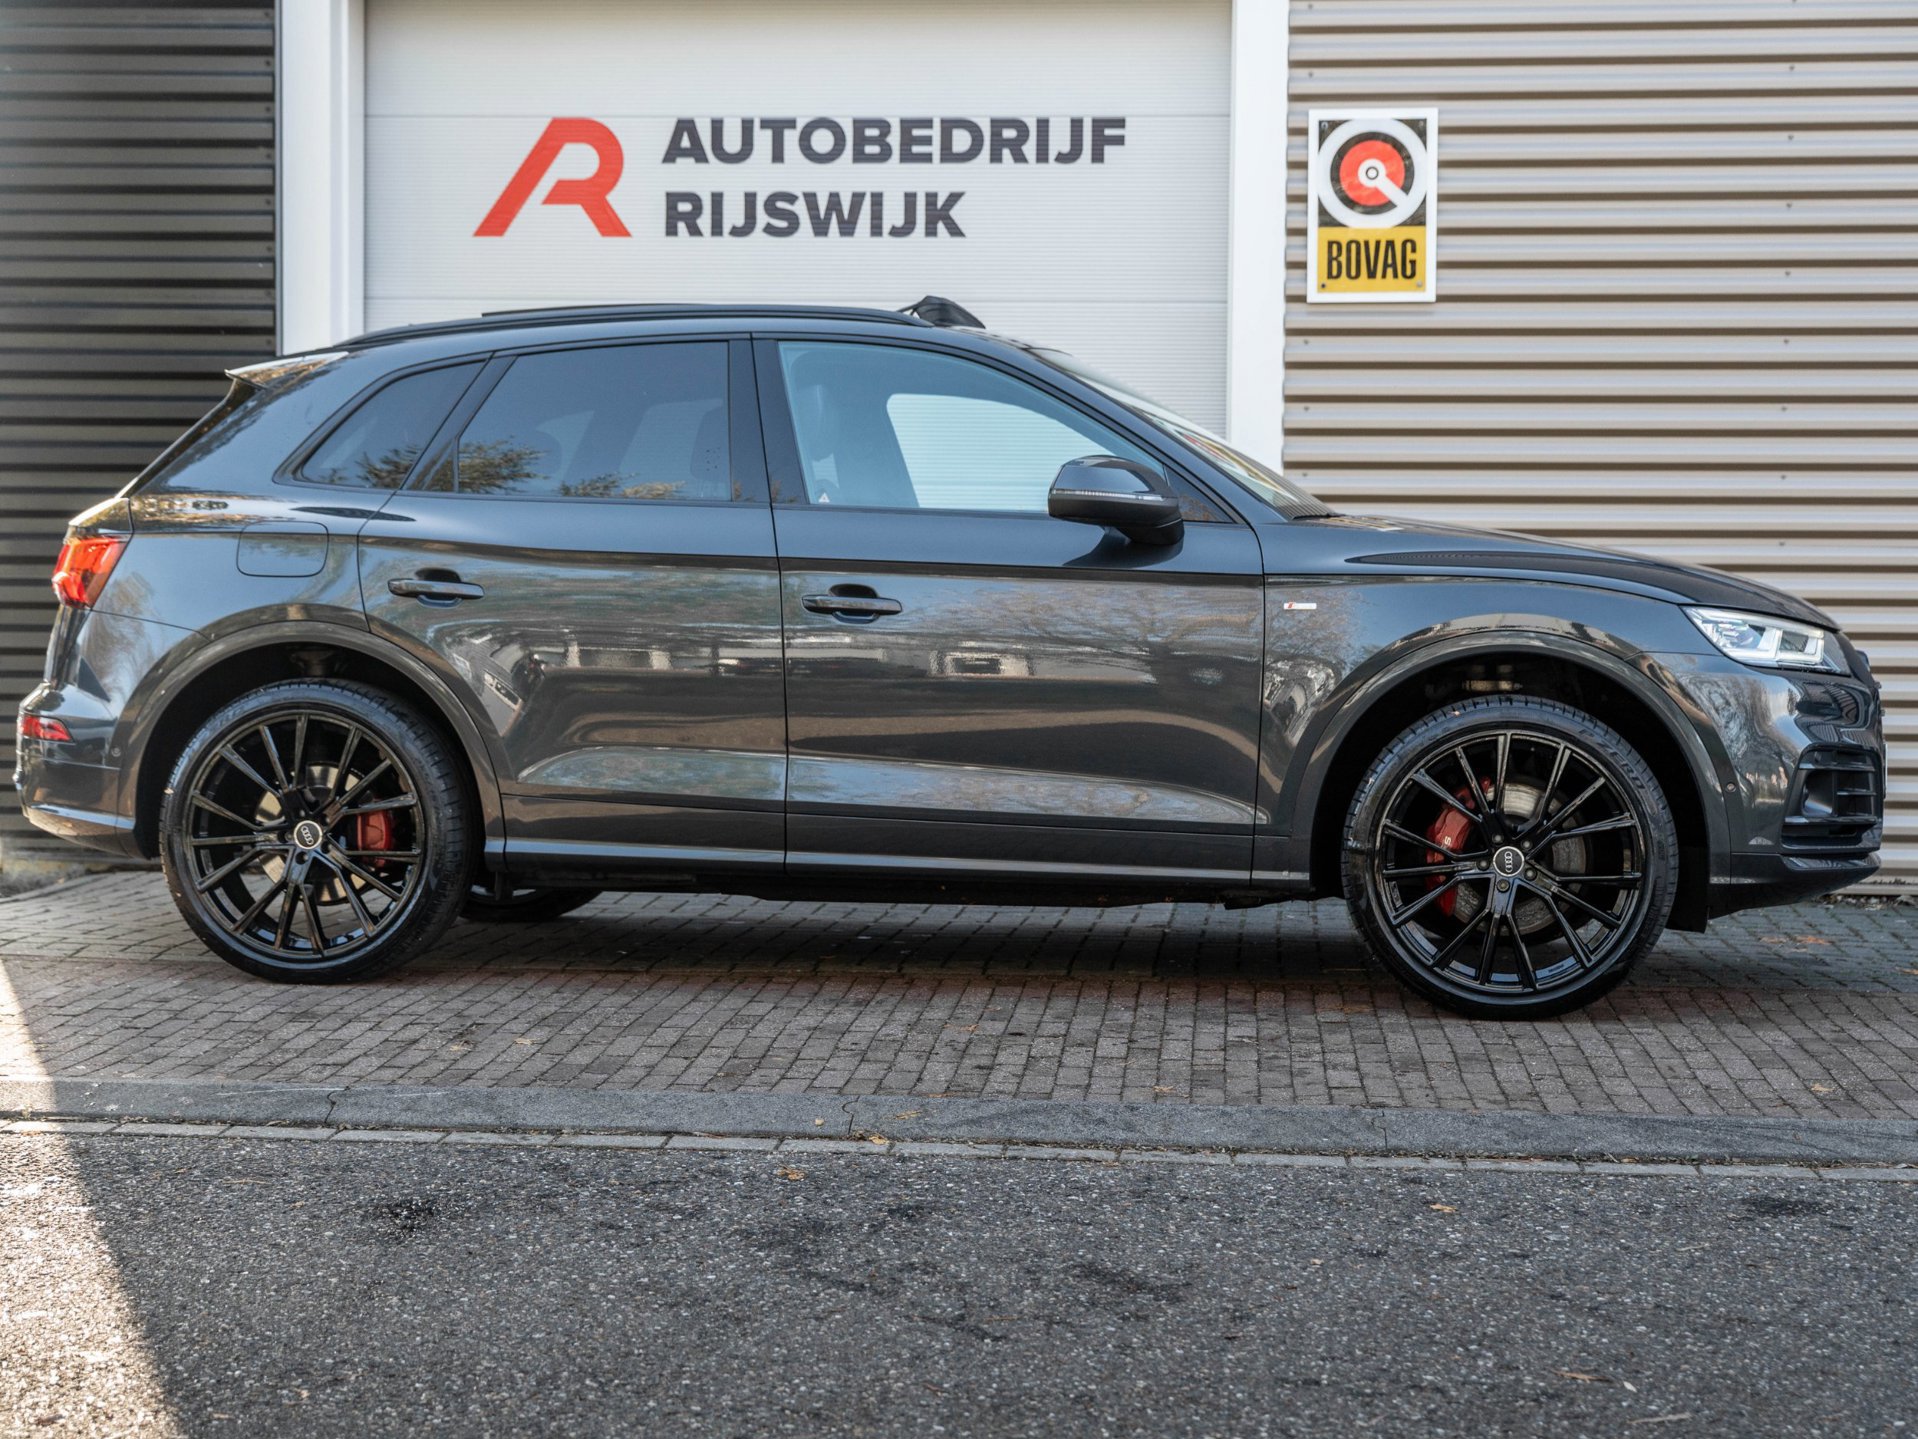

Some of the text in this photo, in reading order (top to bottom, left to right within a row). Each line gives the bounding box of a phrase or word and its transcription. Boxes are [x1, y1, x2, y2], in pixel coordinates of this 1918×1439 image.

[662, 117, 1126, 164] AUTOBEDRIJF
[664, 191, 966, 237] RIJSWIJK
[1326, 239, 1417, 280] BOVAG
